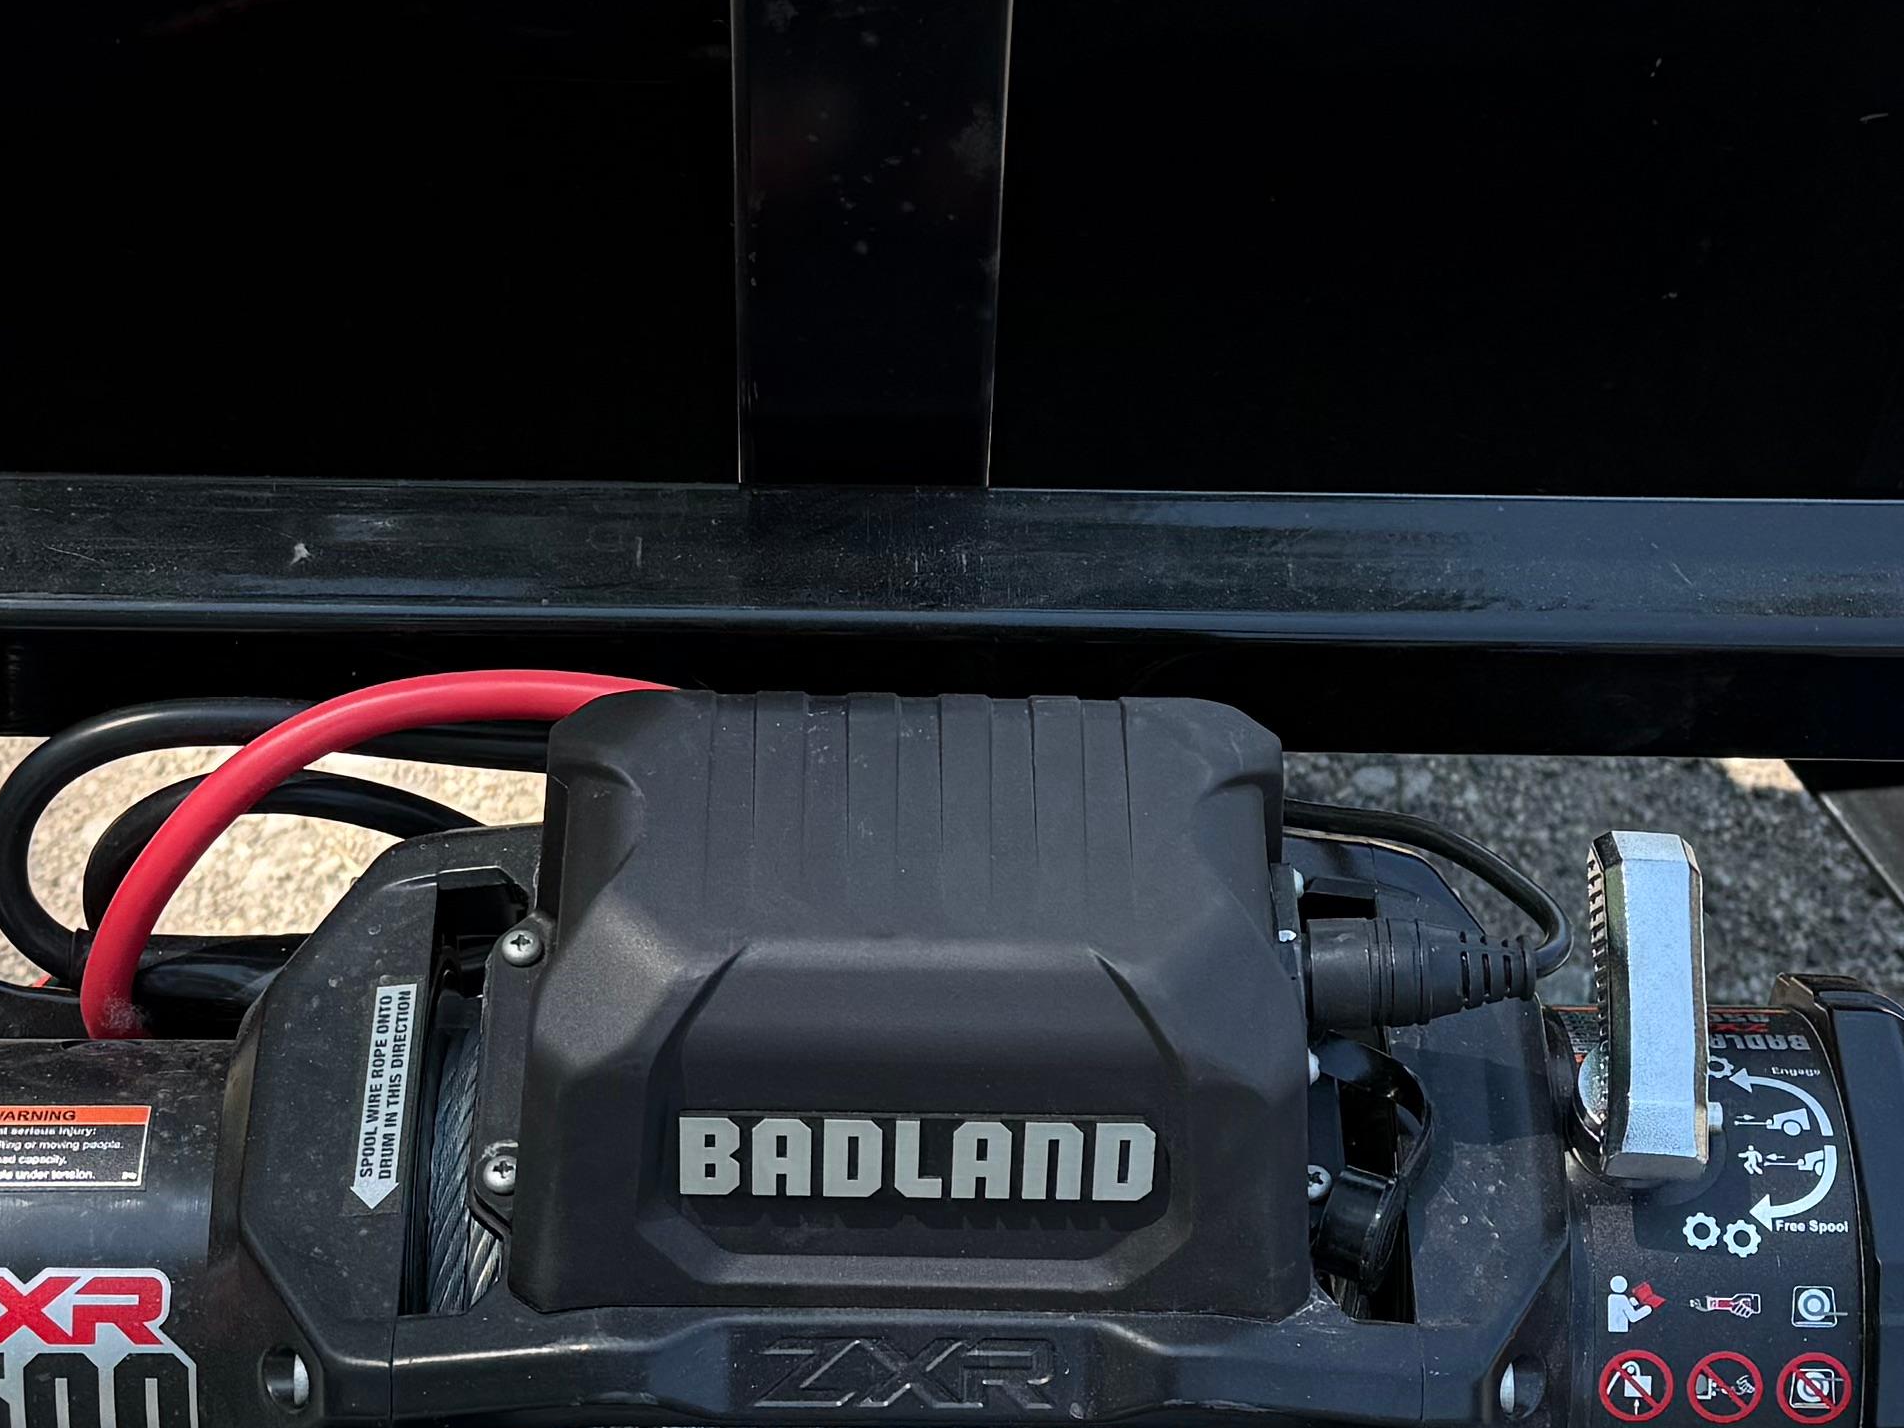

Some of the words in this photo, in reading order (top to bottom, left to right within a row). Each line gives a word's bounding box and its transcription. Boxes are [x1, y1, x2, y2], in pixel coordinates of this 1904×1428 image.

[376, 995, 393, 1034] ONTO
[390, 990, 411, 1069] DIRECTION
[371, 1039, 388, 1079] ROPE
[1709, 1034, 1812, 1051] BADLA
[365, 1083, 383, 1124] WIRE
[386, 1073, 402, 1108] THIS
[11, 1126, 56, 1136] serious
[384, 1112, 398, 1127] IN
[18, 1154, 68, 1166] capacity.
[24, 1141, 37, 1150] or
[39, 1141, 80, 1152] moving
[82, 1140, 124, 1151] people.
[360, 1126, 378, 1178] SPOOL
[378, 1133, 396, 1180] DRUM
[679, 1116, 1156, 1202] BADLAND
[16, 1168, 50, 1180] under
[1776, 1220, 1806, 1232] Free
[1809, 1219, 1849, 1235] Spool
[753, 1335, 1056, 1410] ZXR
